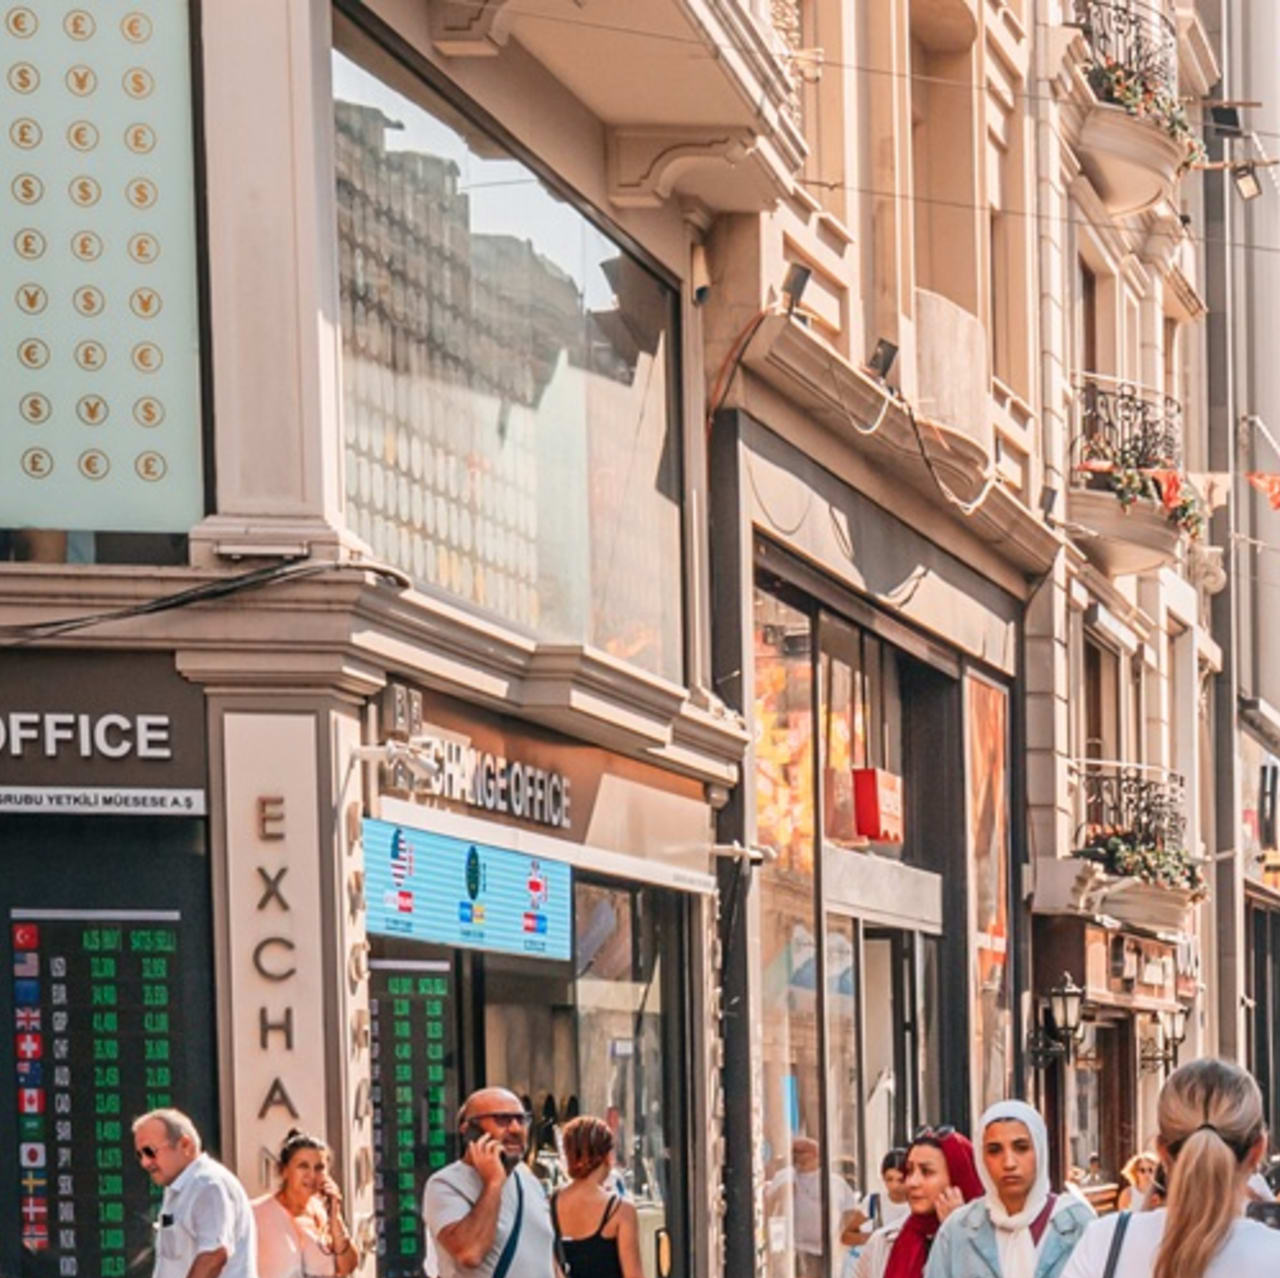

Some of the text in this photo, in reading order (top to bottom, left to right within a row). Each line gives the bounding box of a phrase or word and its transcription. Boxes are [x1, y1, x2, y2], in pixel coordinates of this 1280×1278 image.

[0, 712, 172, 758] FFICE
[49, 793, 99, 806] YETKİLİ
[102, 794, 169, 808] MÜESESE
[414, 736, 572, 829] CHANGE OFFICE
